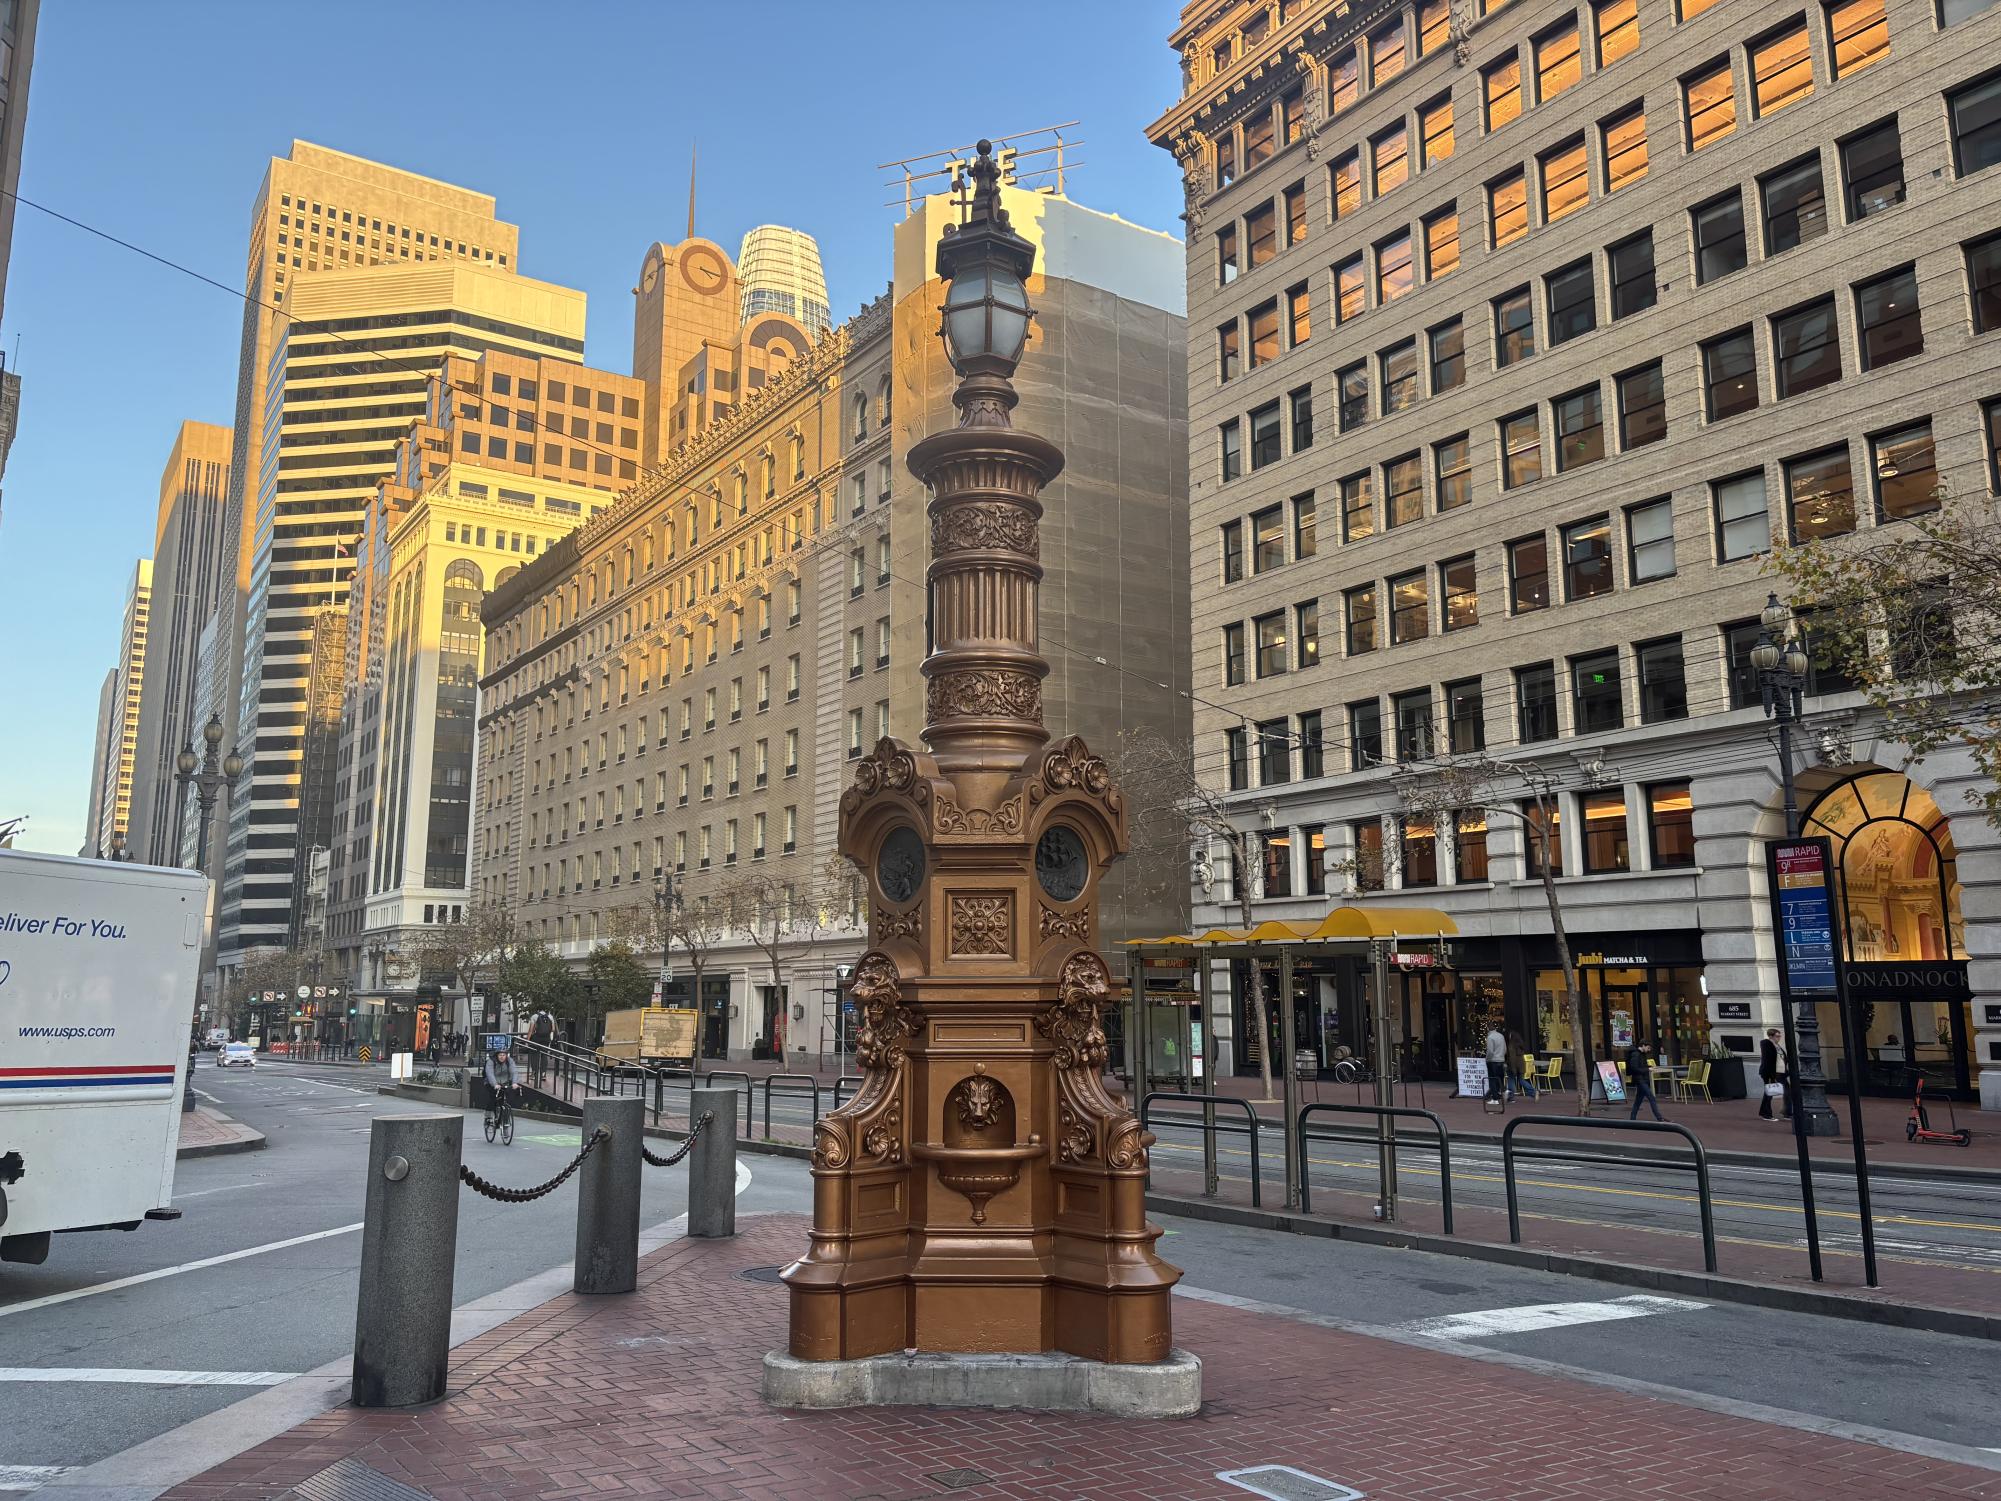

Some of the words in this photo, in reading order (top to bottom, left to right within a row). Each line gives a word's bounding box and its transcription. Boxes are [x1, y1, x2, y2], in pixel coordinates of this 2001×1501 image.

[1795, 845, 1820, 857] RAPID
[1784, 875, 1791, 888] F
[1787, 903, 1794, 915] 7
[52, 917, 86, 936] For
[91, 919, 127, 939] You.
[1788, 917, 1796, 929] 9
[1790, 932, 1797, 943] L
[1792, 946, 1801, 958] N
[1410, 954, 1429, 964] RAPID
[1635, 956, 1648, 964] TEA
[1847, 971, 1969, 987] ONADNOCK
[19, 1027, 115, 1040] www.usps.com
